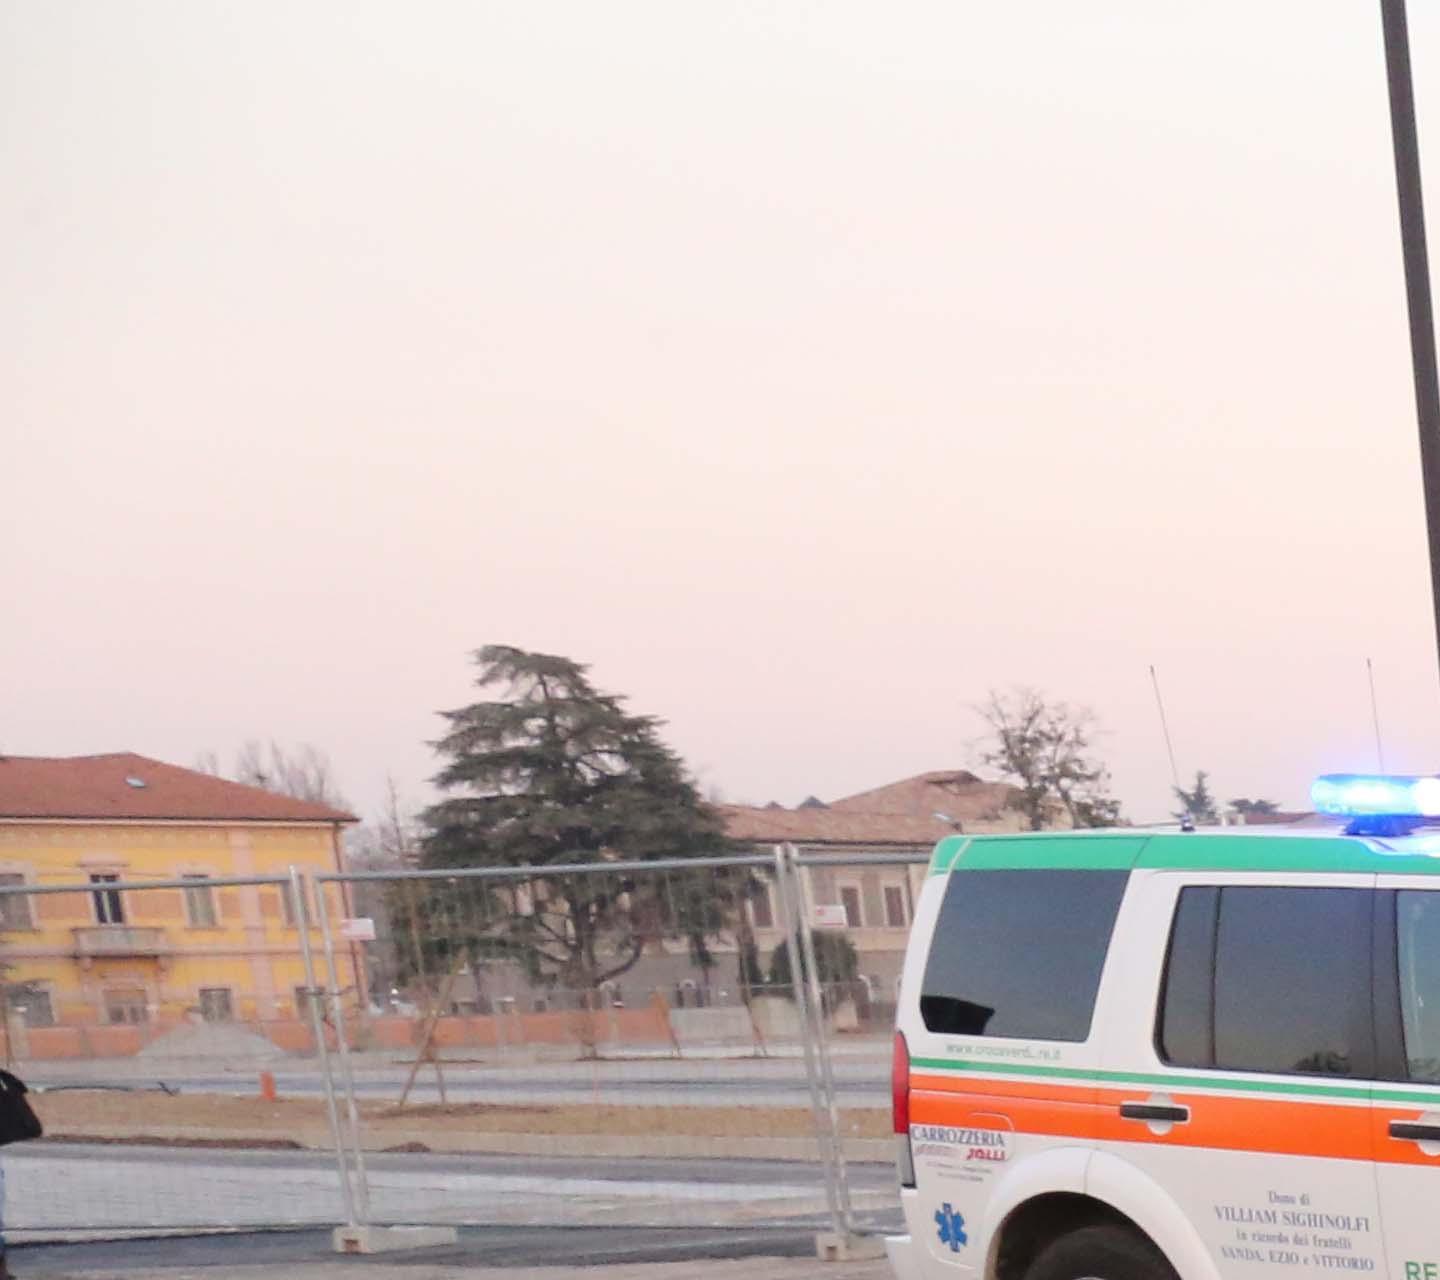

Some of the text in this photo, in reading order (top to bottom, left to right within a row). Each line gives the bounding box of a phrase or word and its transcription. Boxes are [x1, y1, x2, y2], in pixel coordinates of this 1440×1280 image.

[912, 1126, 1006, 1147] CARROZZERIA
[1299, 1193, 1311, 1206] di
[1214, 1206, 1370, 1232] VILLIAM SIGHINOLFI
[1313, 1235, 1353, 1250] fratelli
[1269, 1251, 1300, 1266] EZIO
[1313, 1254, 1375, 1271] VITTORIO
